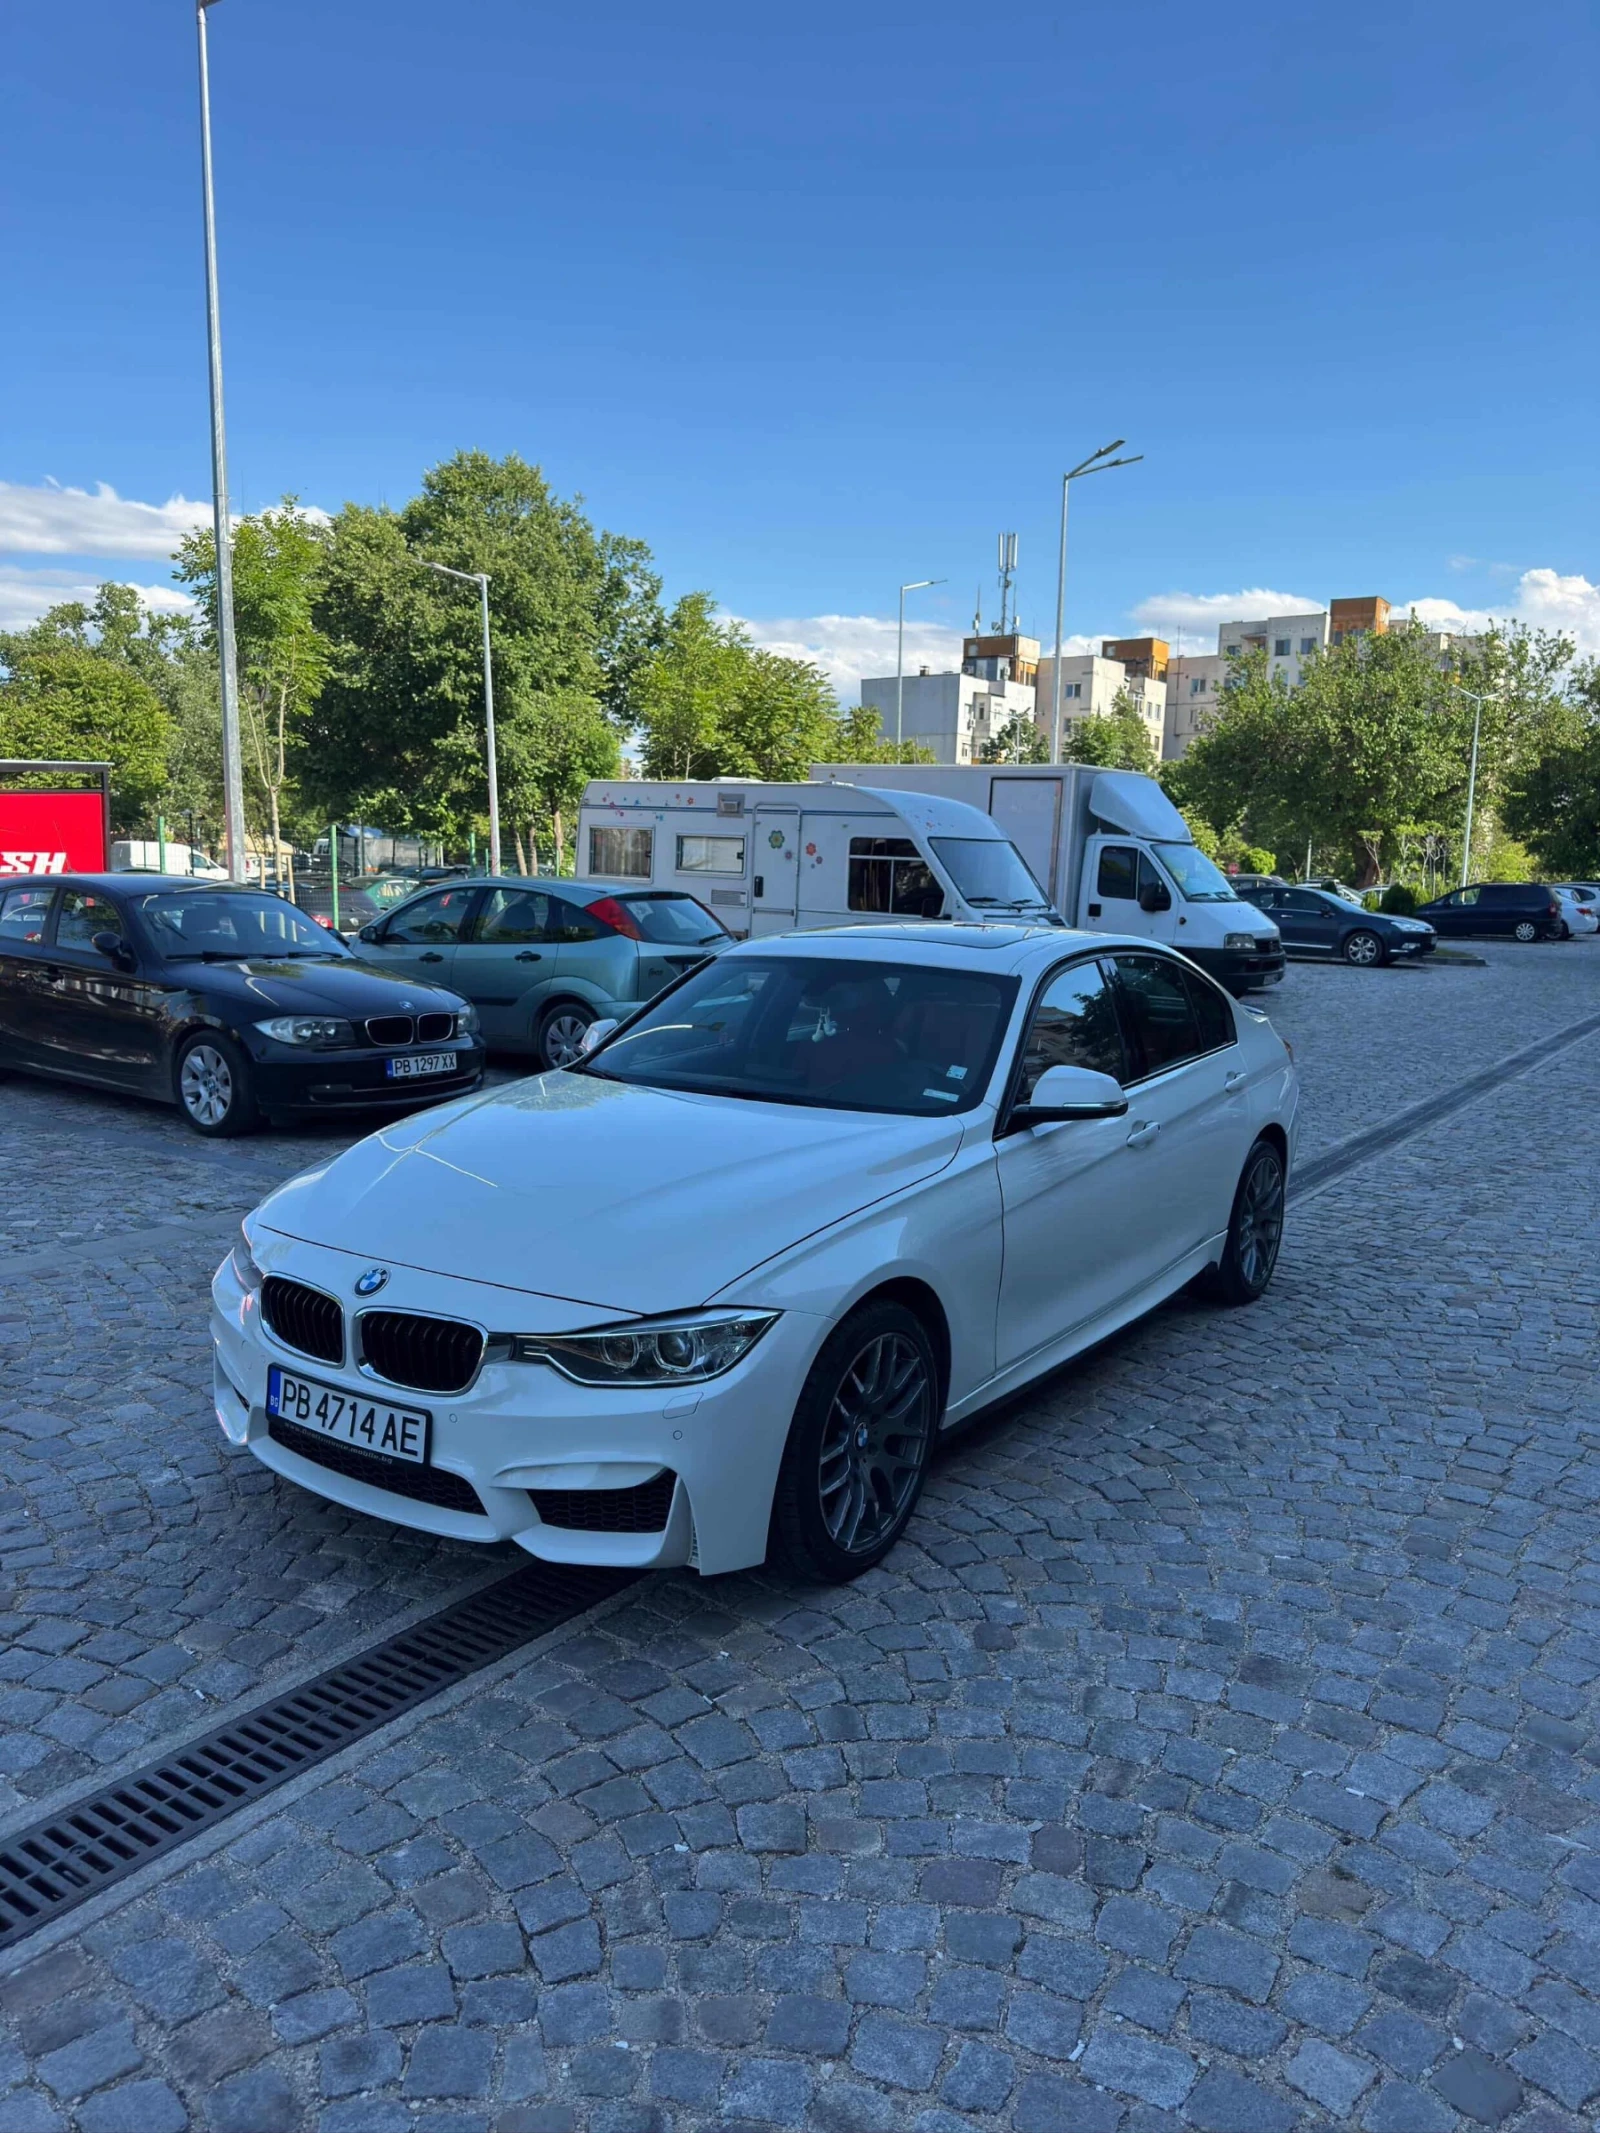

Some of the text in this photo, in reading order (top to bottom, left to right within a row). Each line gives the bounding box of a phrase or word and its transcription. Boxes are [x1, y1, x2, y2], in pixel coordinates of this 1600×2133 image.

[395, 1060, 411, 1074] PB
[414, 1056, 439, 1072] 1297
[442, 1054, 455, 1069] XX
[270, 1395, 279, 1408] BG
[282, 1378, 420, 1457] PB 4714 AE
